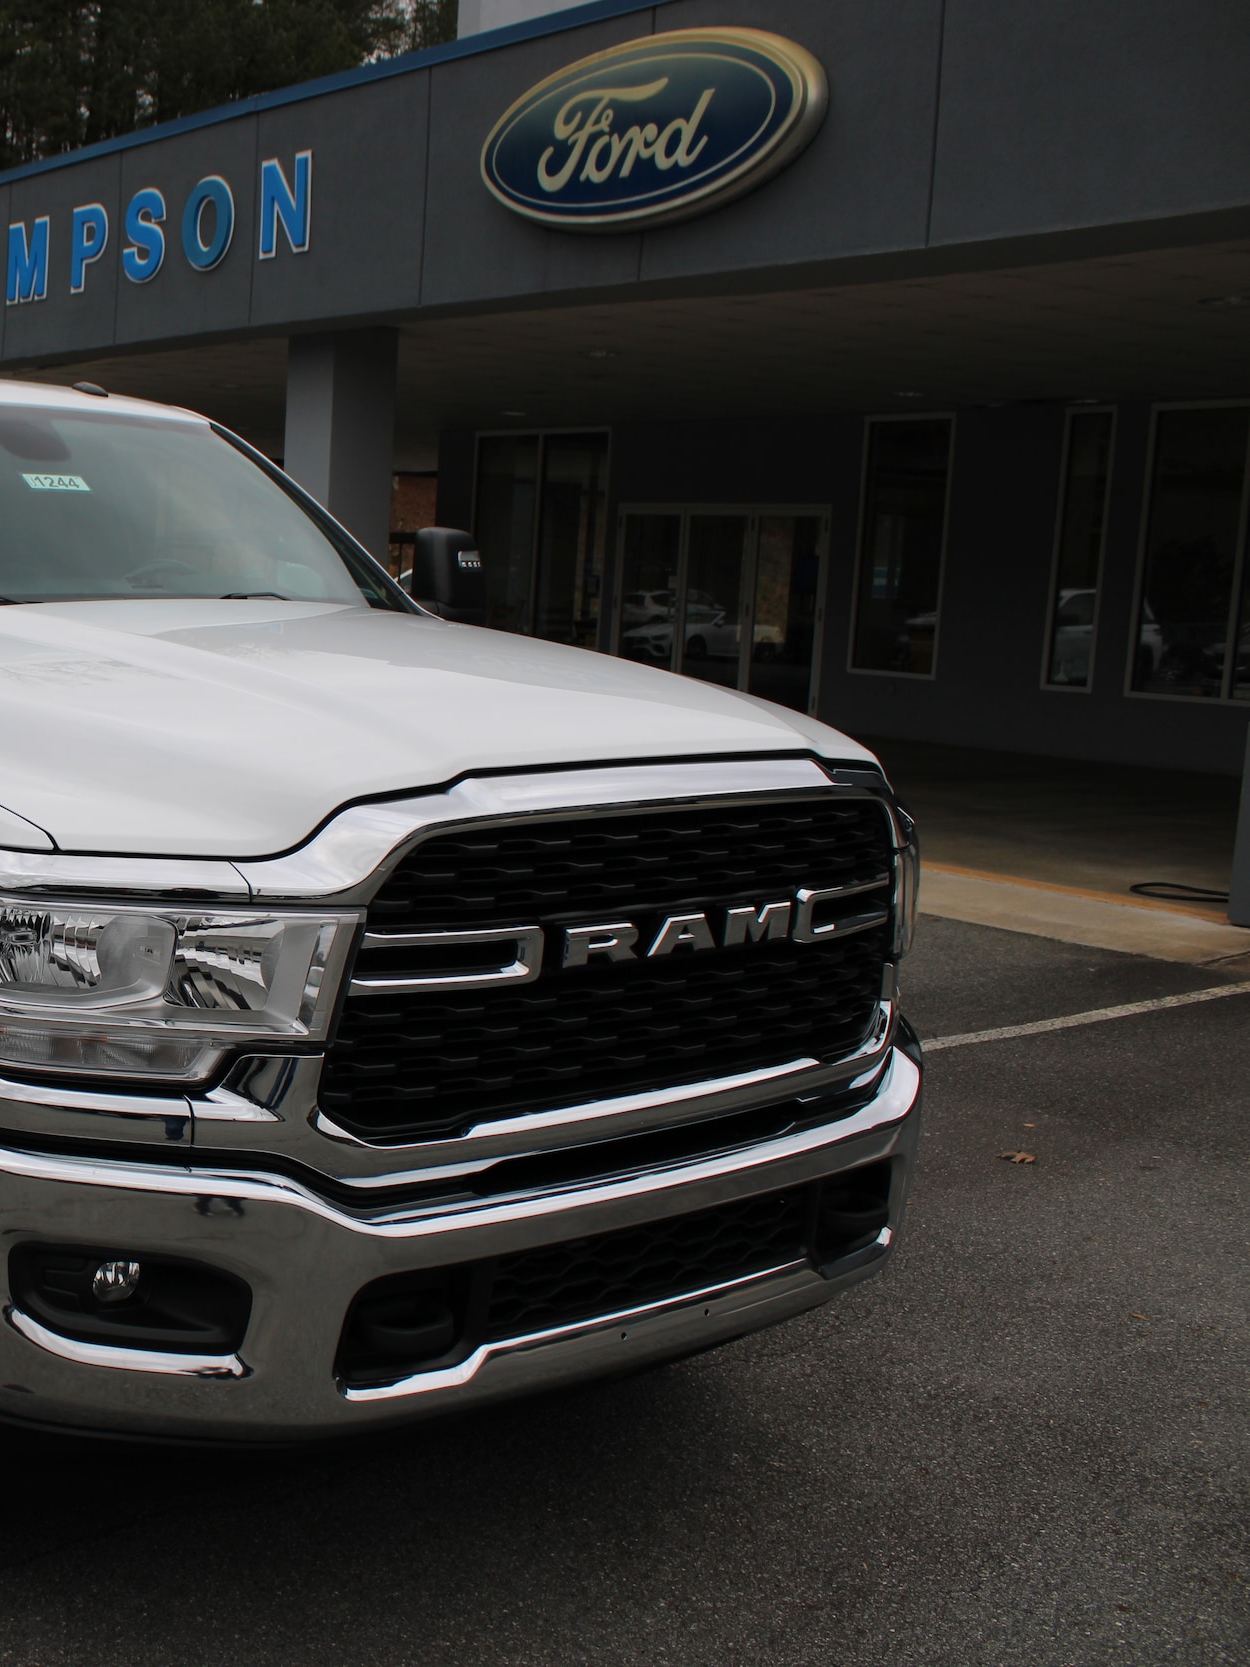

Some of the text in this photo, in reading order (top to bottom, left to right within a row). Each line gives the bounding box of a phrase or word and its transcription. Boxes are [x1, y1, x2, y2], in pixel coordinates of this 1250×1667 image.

[537, 77, 716, 192] Ford
[34, 475, 80, 489] 1244
[562, 902, 792, 968] RAM
